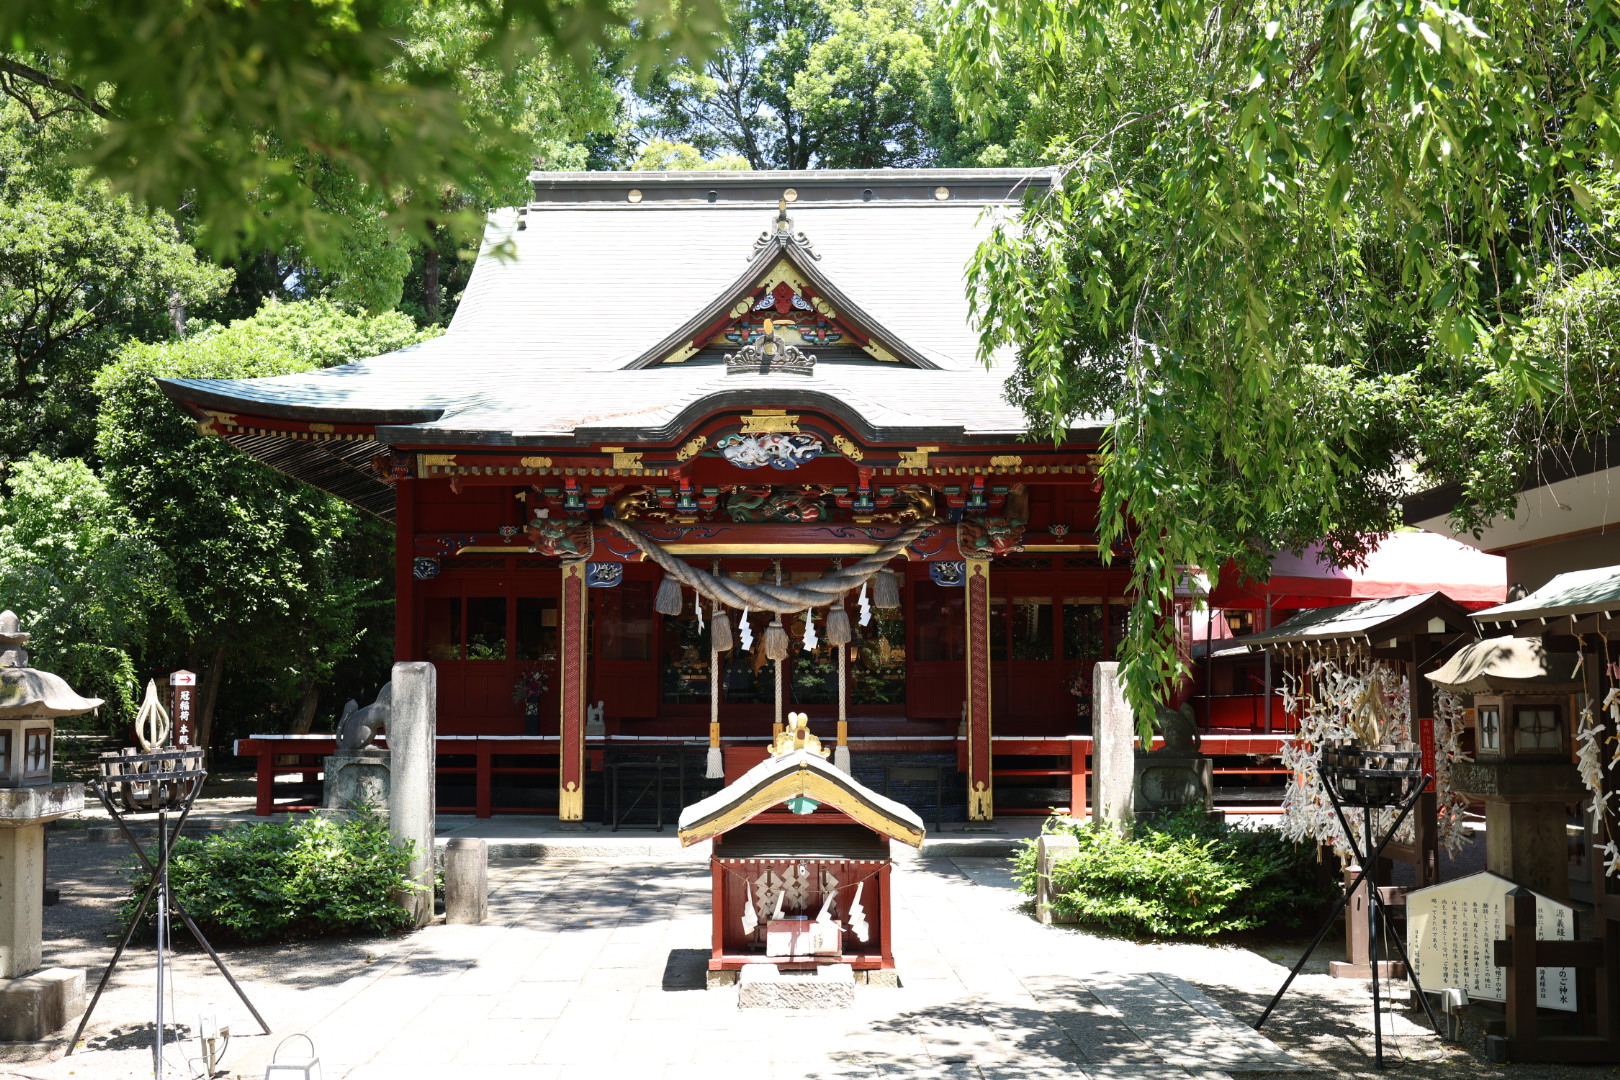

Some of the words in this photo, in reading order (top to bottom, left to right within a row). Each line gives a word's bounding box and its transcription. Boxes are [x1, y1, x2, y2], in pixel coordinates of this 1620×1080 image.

[179, 690, 191, 721] 冠稲荷
[178, 724, 190, 745] 本殿
[1556, 909, 1568, 1004] 源義経のご神水
